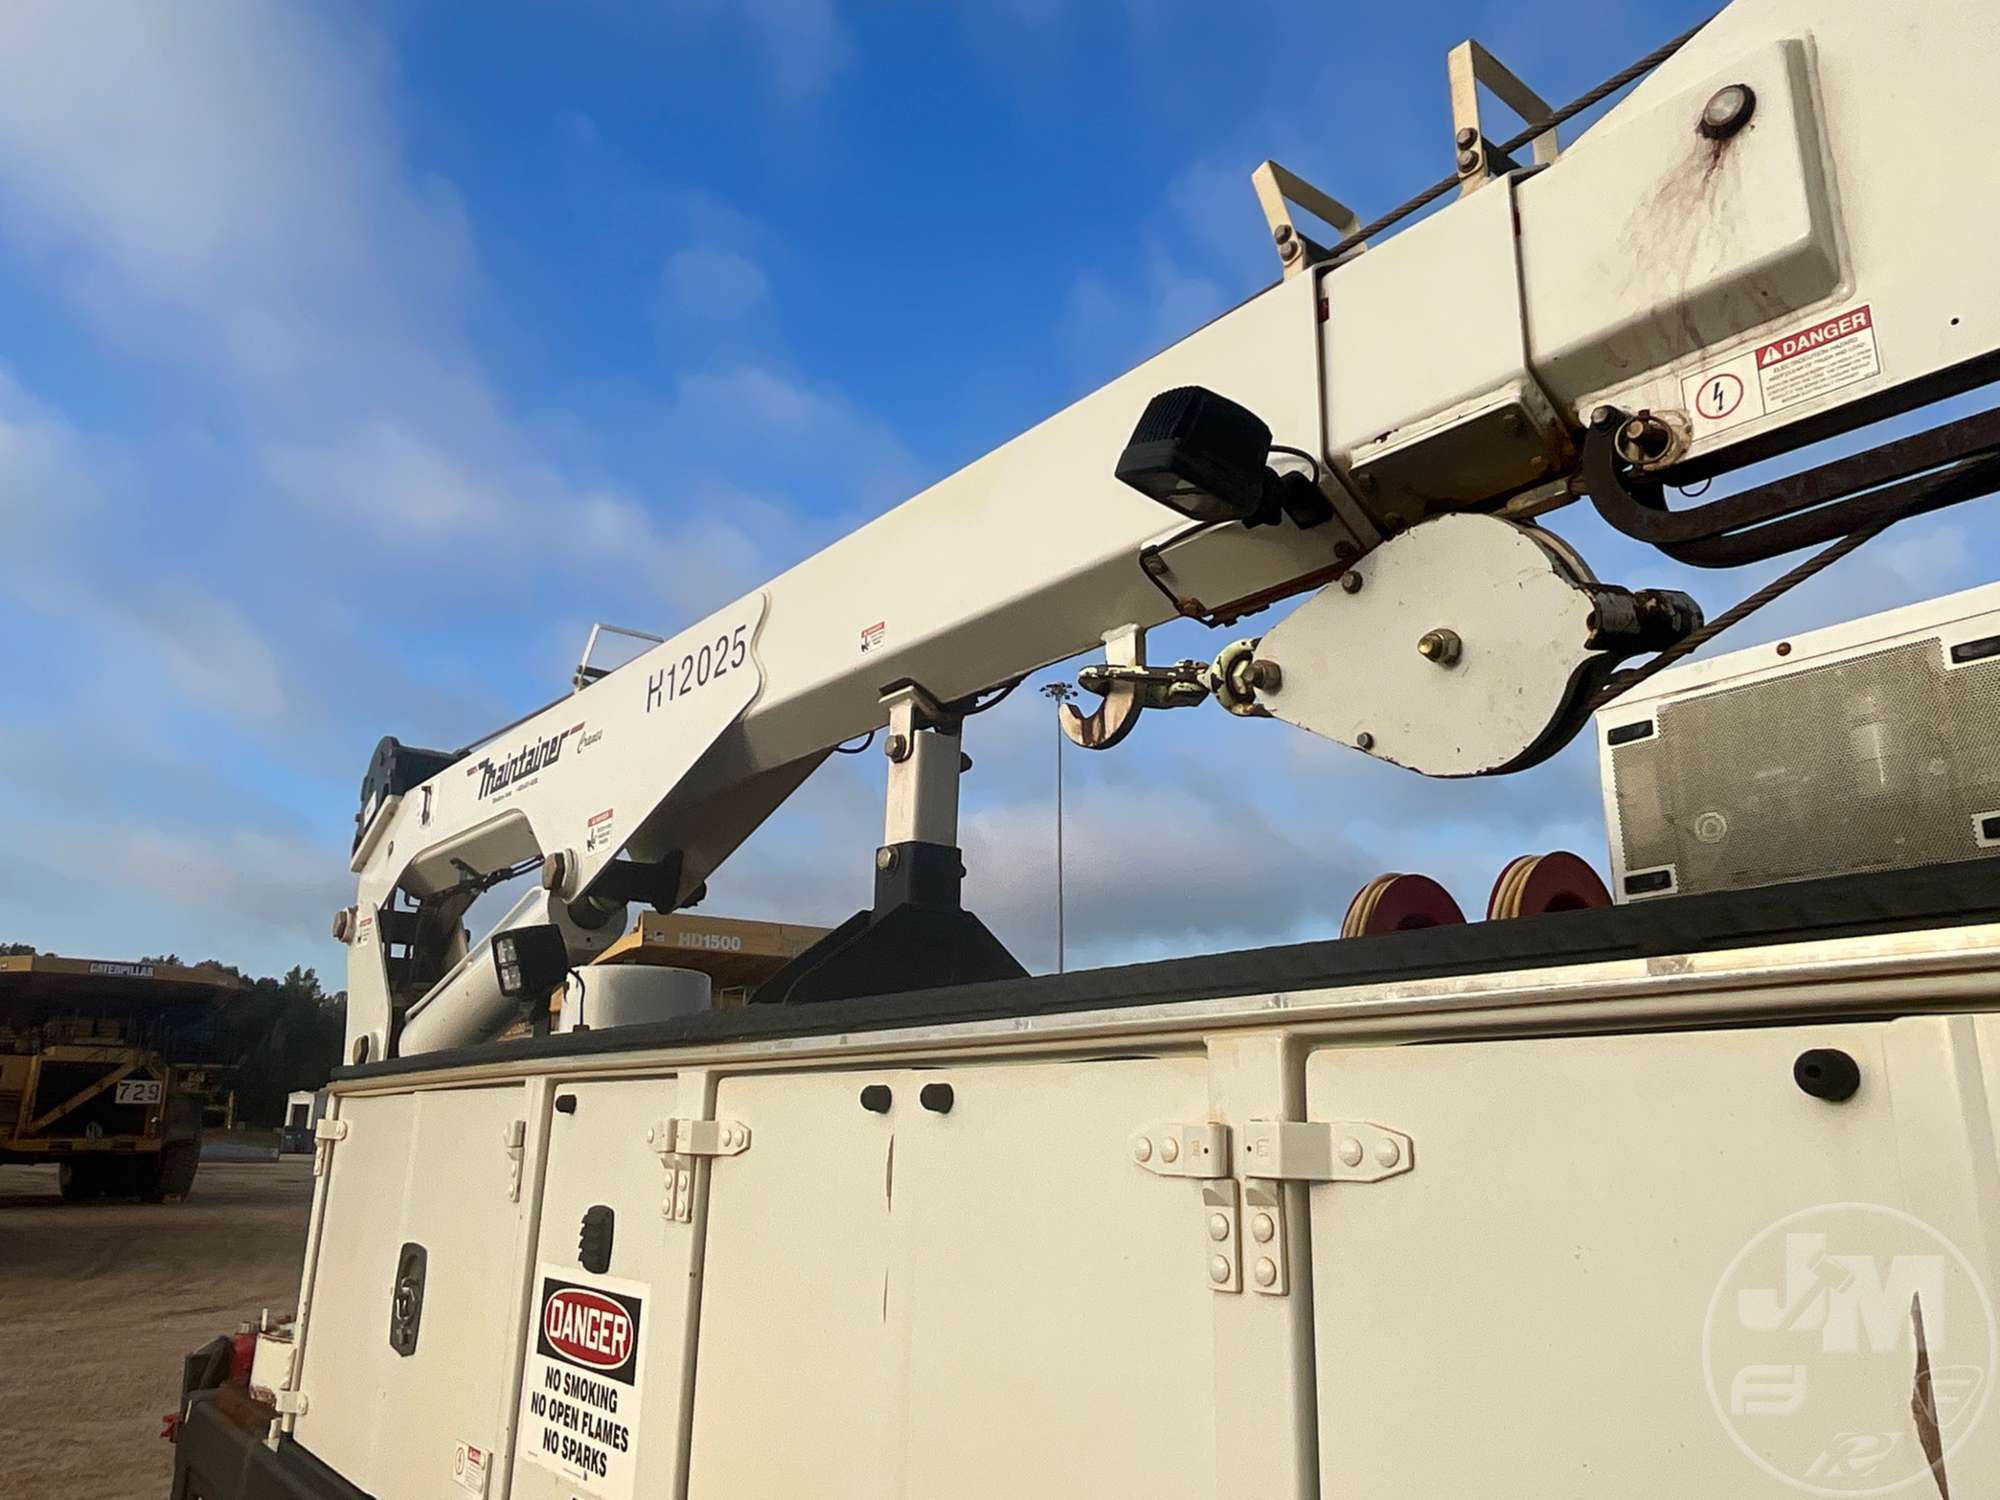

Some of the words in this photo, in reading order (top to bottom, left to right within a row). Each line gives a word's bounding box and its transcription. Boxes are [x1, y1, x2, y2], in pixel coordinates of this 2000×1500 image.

[1782, 312, 1867, 356] DANGER
[646, 624, 746, 713] H12025
[477, 729, 570, 801] Maintainer
[679, 932, 741, 951] HD1500
[89, 962, 154, 977] CATERPILLAR
[119, 1082, 160, 1101] 729
[549, 1298, 628, 1359] DANGER
[545, 1365, 561, 1391] NO
[563, 1373, 618, 1414] SMOKING
[530, 1391, 547, 1417] NO
[549, 1398, 579, 1431] OPEN
[581, 1413, 630, 1453] FLAMES
[542, 1427, 559, 1455] NO
[561, 1435, 607, 1478] SPARKS
